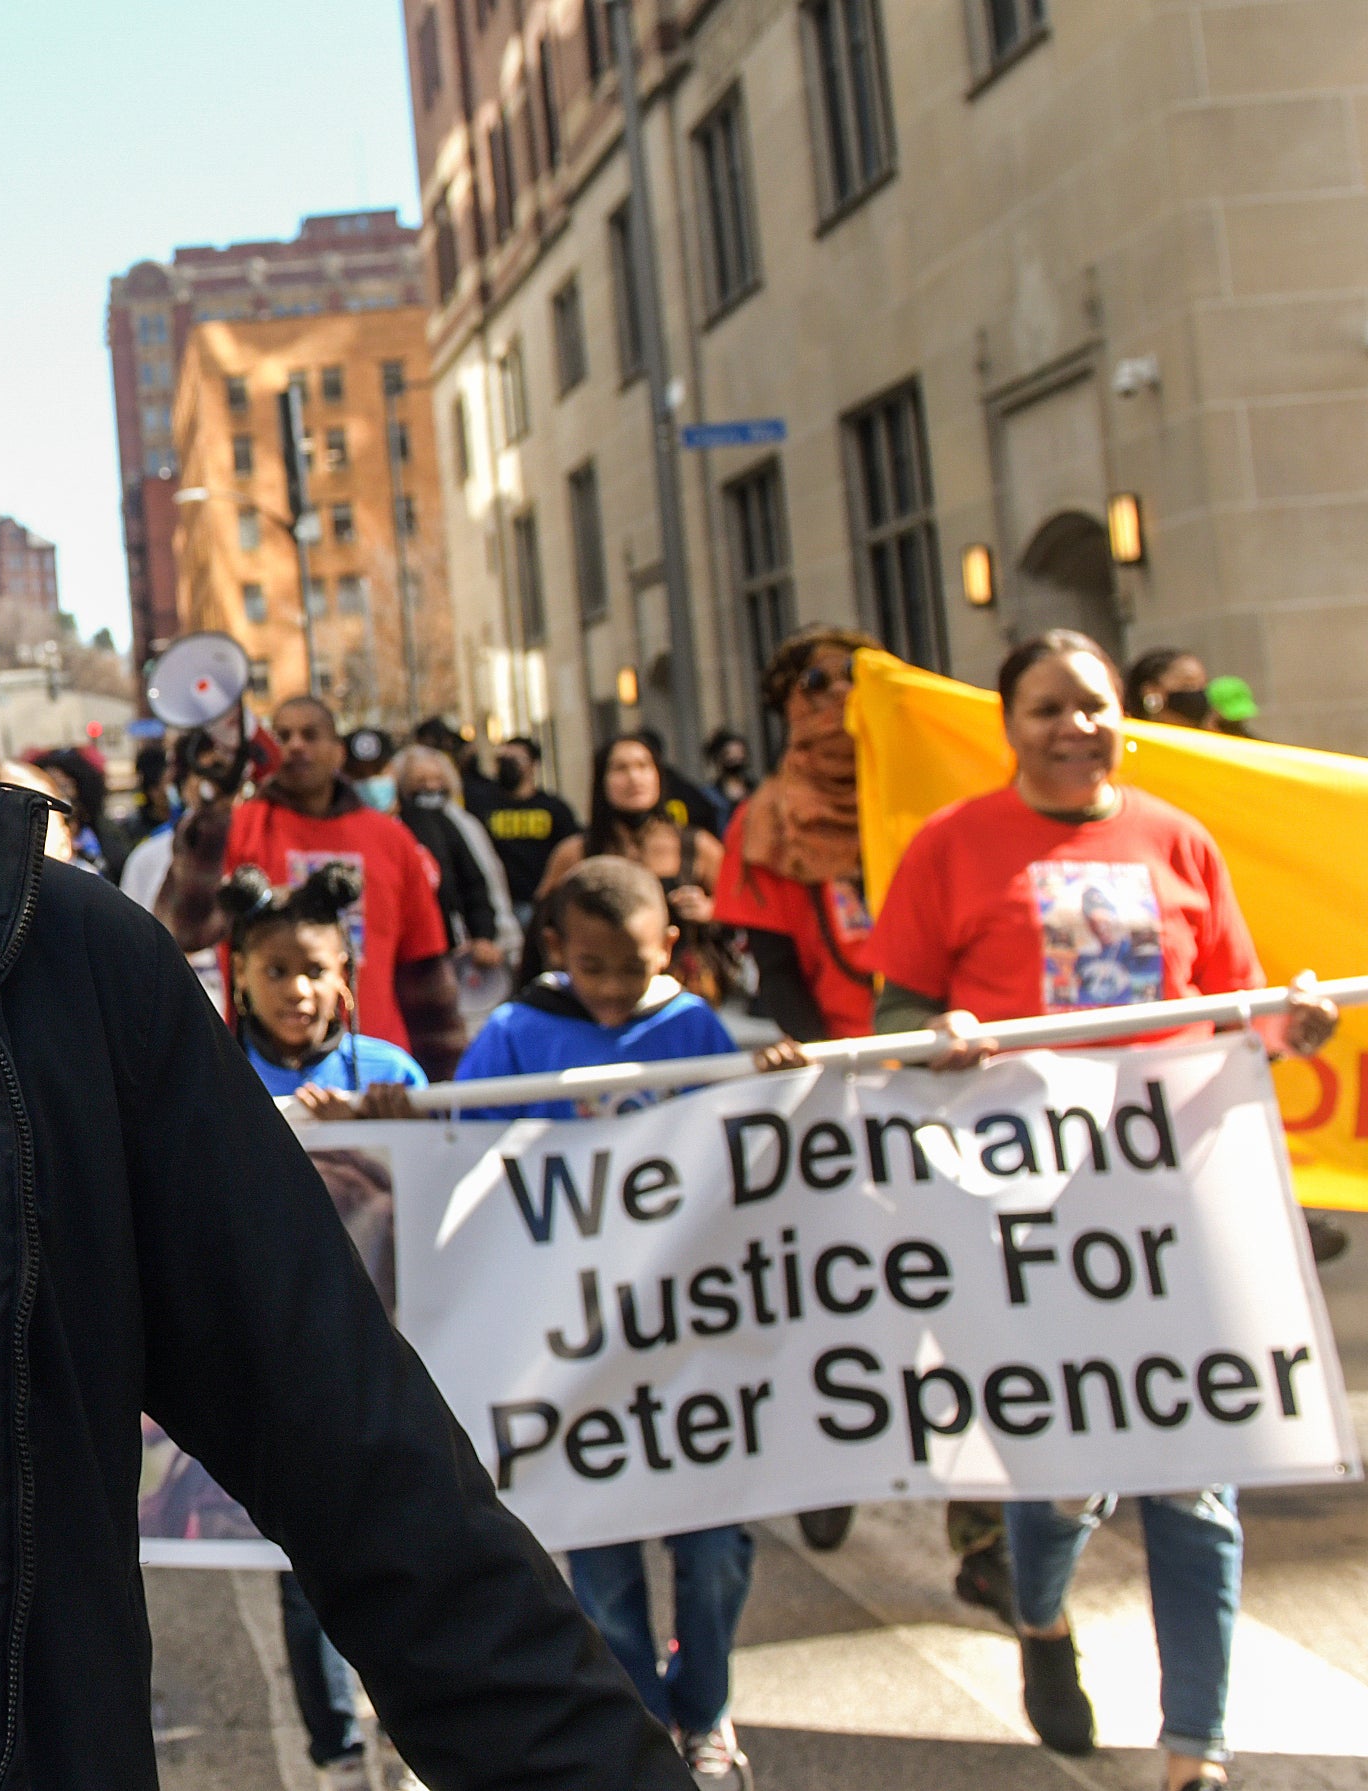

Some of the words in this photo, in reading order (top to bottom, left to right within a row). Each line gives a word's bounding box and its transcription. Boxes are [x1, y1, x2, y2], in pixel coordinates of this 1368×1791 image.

[503, 1150, 682, 1243] We
[724, 1082, 1178, 1205] Demand
[546, 1229, 951, 1359] Justice
[998, 1211, 1175, 1303] For
[491, 1381, 772, 1491] Peter
[813, 1345, 1309, 1463] Spencer
